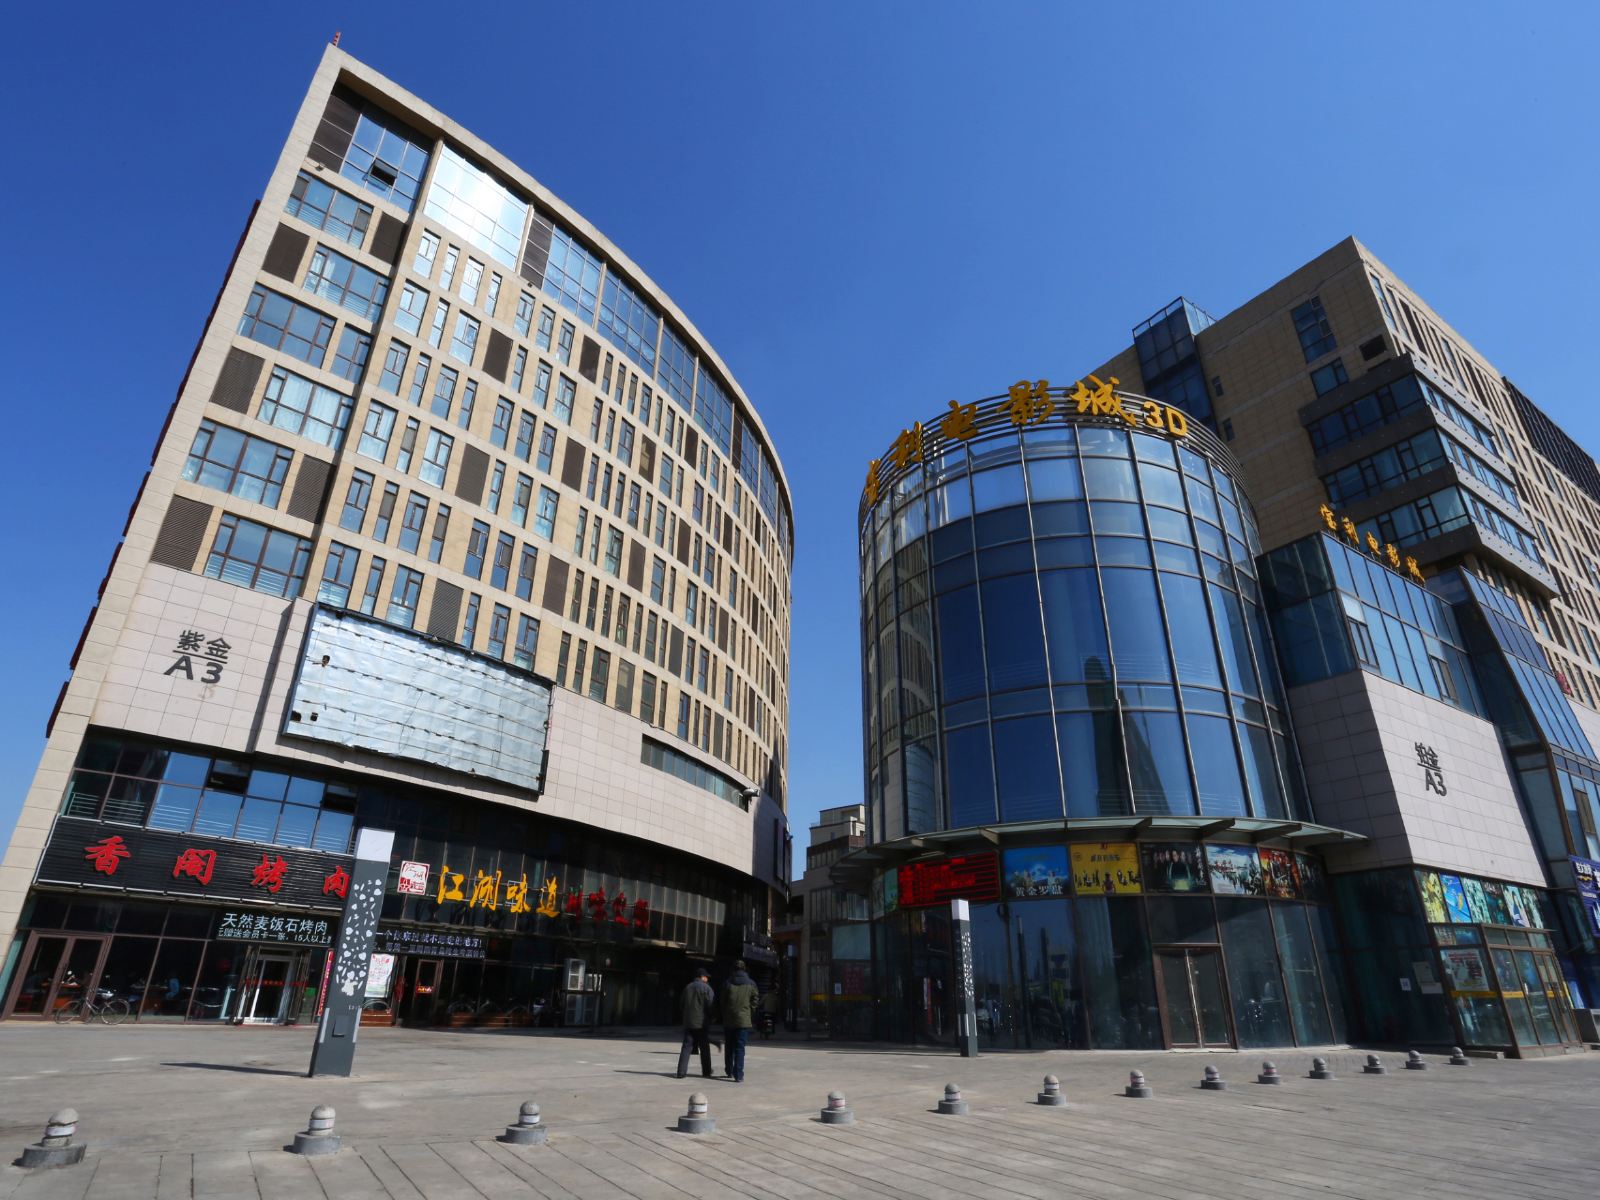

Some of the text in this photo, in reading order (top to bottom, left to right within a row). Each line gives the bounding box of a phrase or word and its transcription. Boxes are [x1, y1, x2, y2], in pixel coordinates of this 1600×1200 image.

[1143, 401, 1188, 437] 3D
[177, 630, 232, 660] 紫金
[163, 654, 224, 685] A3
[1425, 770, 1448, 797] A3
[437, 865, 560, 918] 江湖味道
[221, 912, 328, 935] 天然麦饭石烤肉
